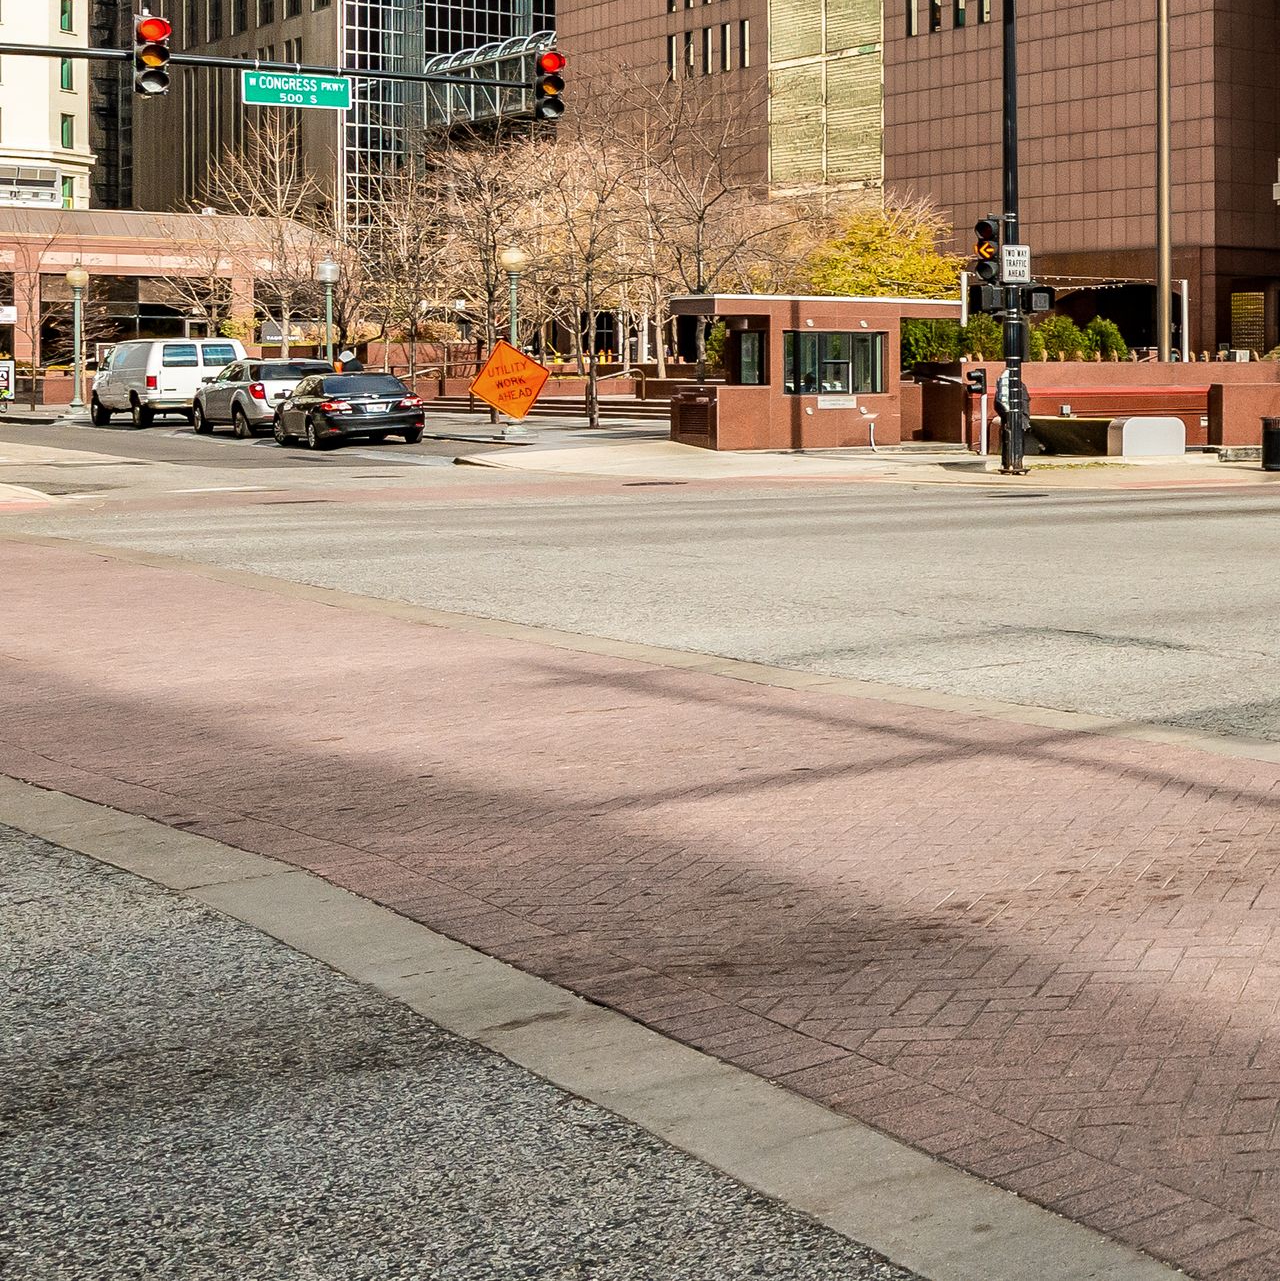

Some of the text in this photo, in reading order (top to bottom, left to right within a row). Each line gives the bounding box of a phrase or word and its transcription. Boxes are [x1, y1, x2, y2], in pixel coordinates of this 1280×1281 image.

[249, 76, 345, 93] W CONGRESS PKWY
[279, 93, 318, 104] 500 S
[1005, 259, 1027, 267] TRAFFIC
[1008, 269, 1025, 277] AHEAD
[487, 361, 527, 377] UTILITY
[496, 376, 526, 388] WORK
[498, 387, 533, 402] AHEAD
